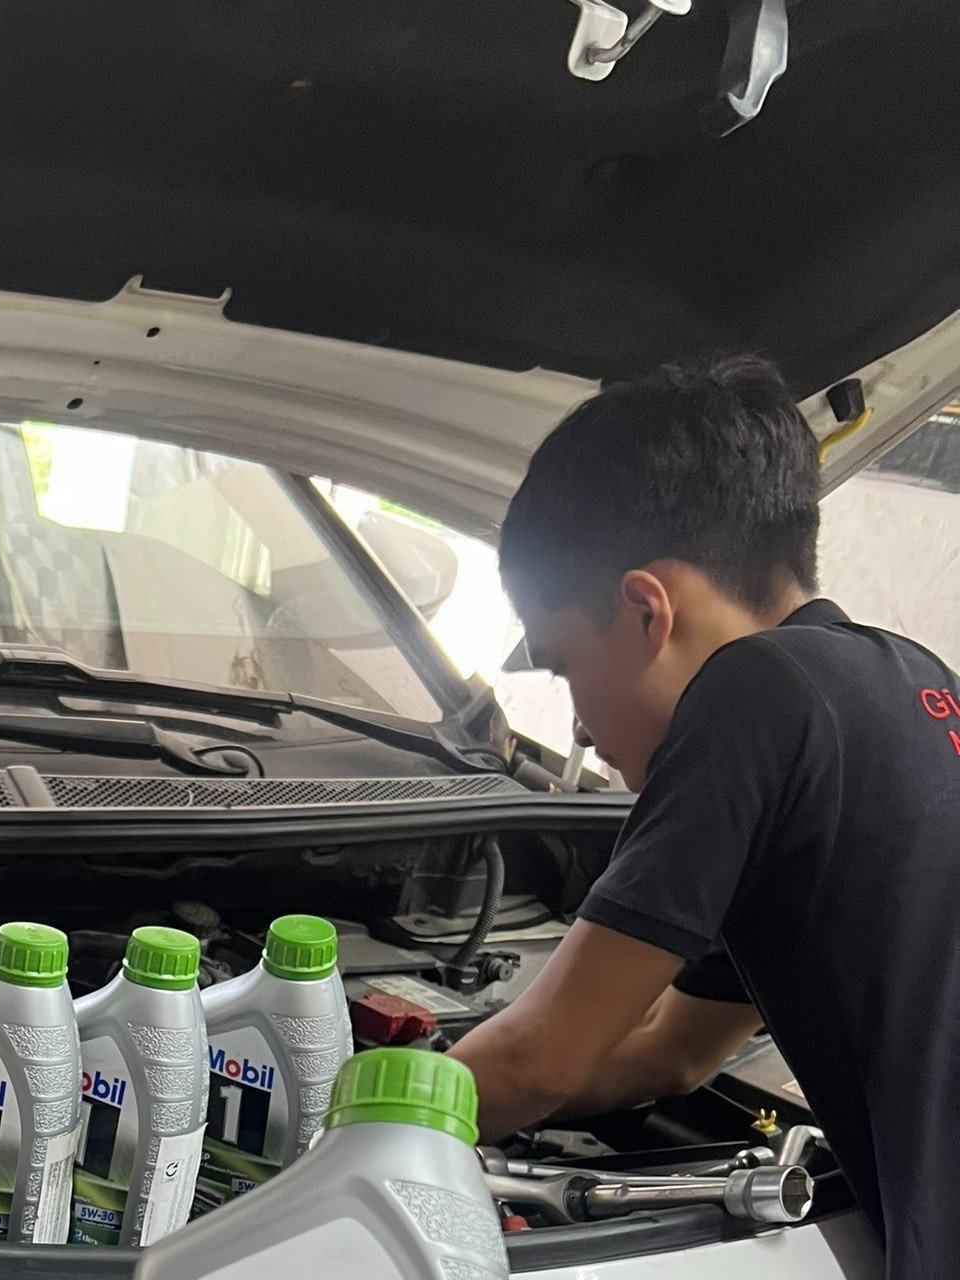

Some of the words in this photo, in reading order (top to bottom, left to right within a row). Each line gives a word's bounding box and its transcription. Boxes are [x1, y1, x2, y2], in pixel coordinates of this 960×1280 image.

[920, 687, 960, 719] Gi
[208, 1045, 275, 1091] Mobil
[82, 1070, 127, 1107] obil
[220, 1084, 243, 1146] 1
[237, 1181, 256, 1192] 5W
[81, 1206, 115, 1222] 5W-30
